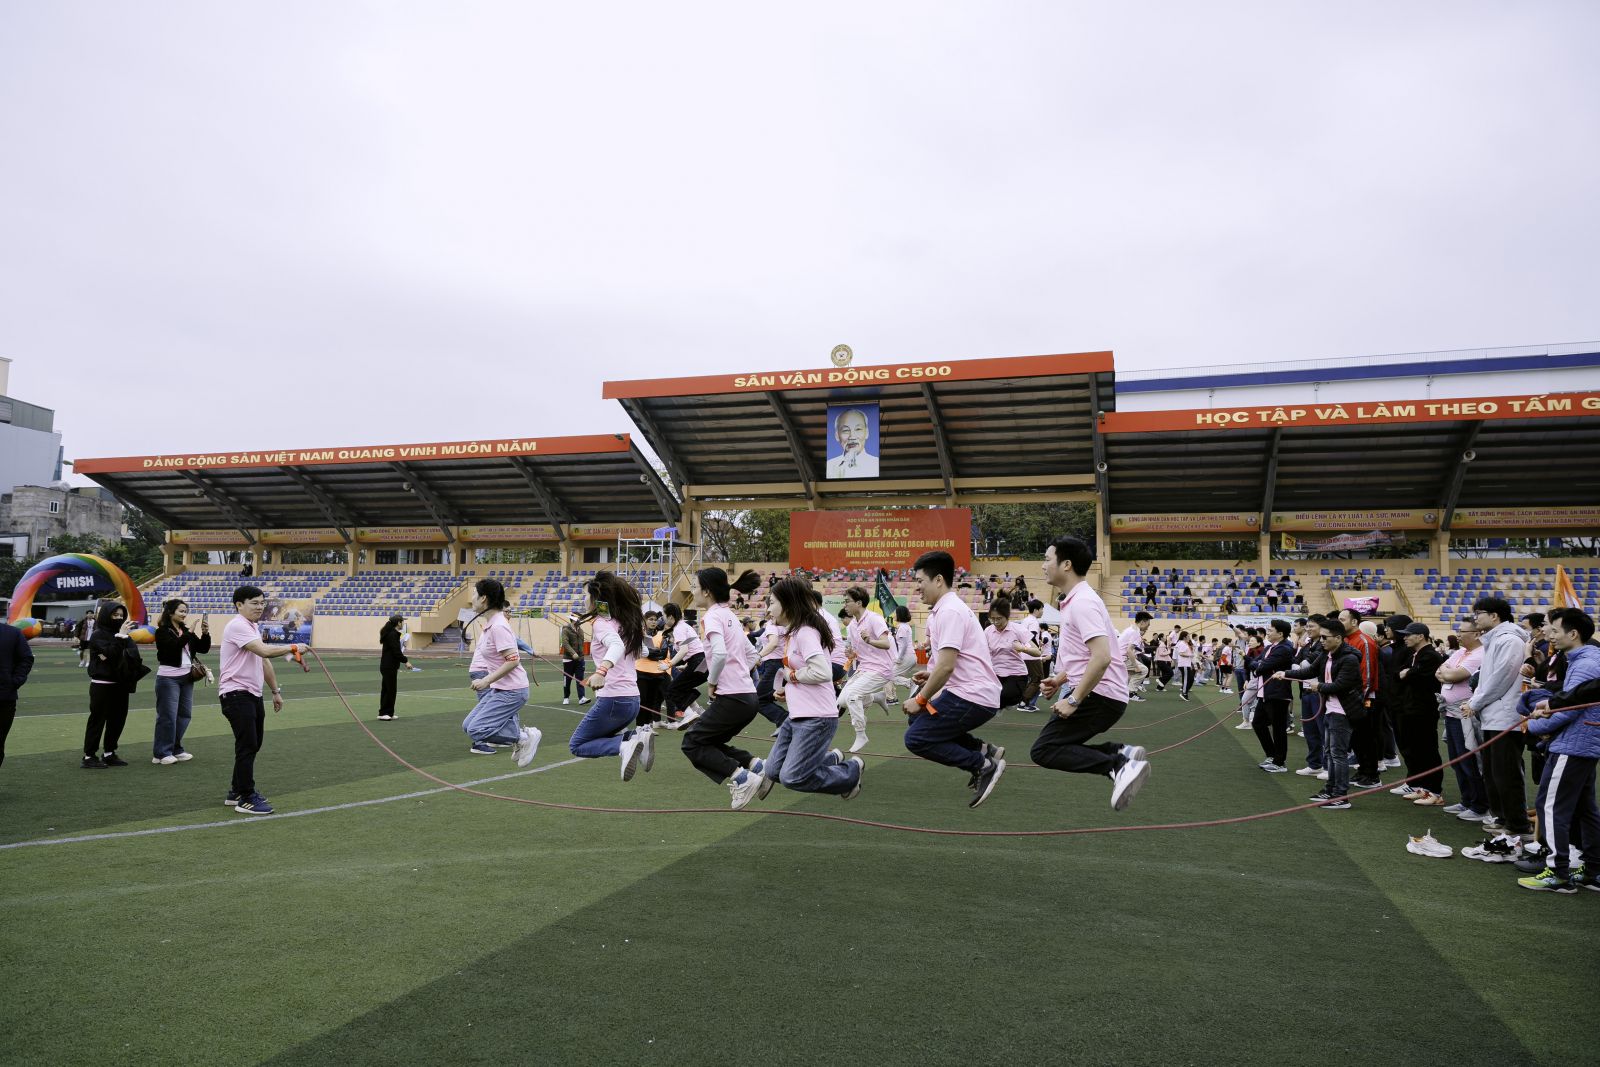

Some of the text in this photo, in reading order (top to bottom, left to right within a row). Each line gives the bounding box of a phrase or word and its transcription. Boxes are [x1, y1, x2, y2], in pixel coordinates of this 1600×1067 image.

[734, 365, 952, 387] SÂN VẬN ĐỘNG C500
[1196, 411, 1249, 427] HỌC
[1256, 407, 1307, 424] TẬP
[1314, 404, 1349, 420] VÀ
[1357, 402, 1416, 419] LÀM
[1424, 401, 1498, 416] THEO
[1507, 393, 1572, 413] TẤM
[143, 439, 537, 468] ĐẢNG CỘNG SẢN VIỆT NAM QUANG VINH MUÔN NĂM
[847, 524, 910, 540] LỄ BẾ MẠC
[875, 550, 890, 558] 2024
[894, 550, 910, 558] 2025
[56, 575, 95, 589] FINISH
